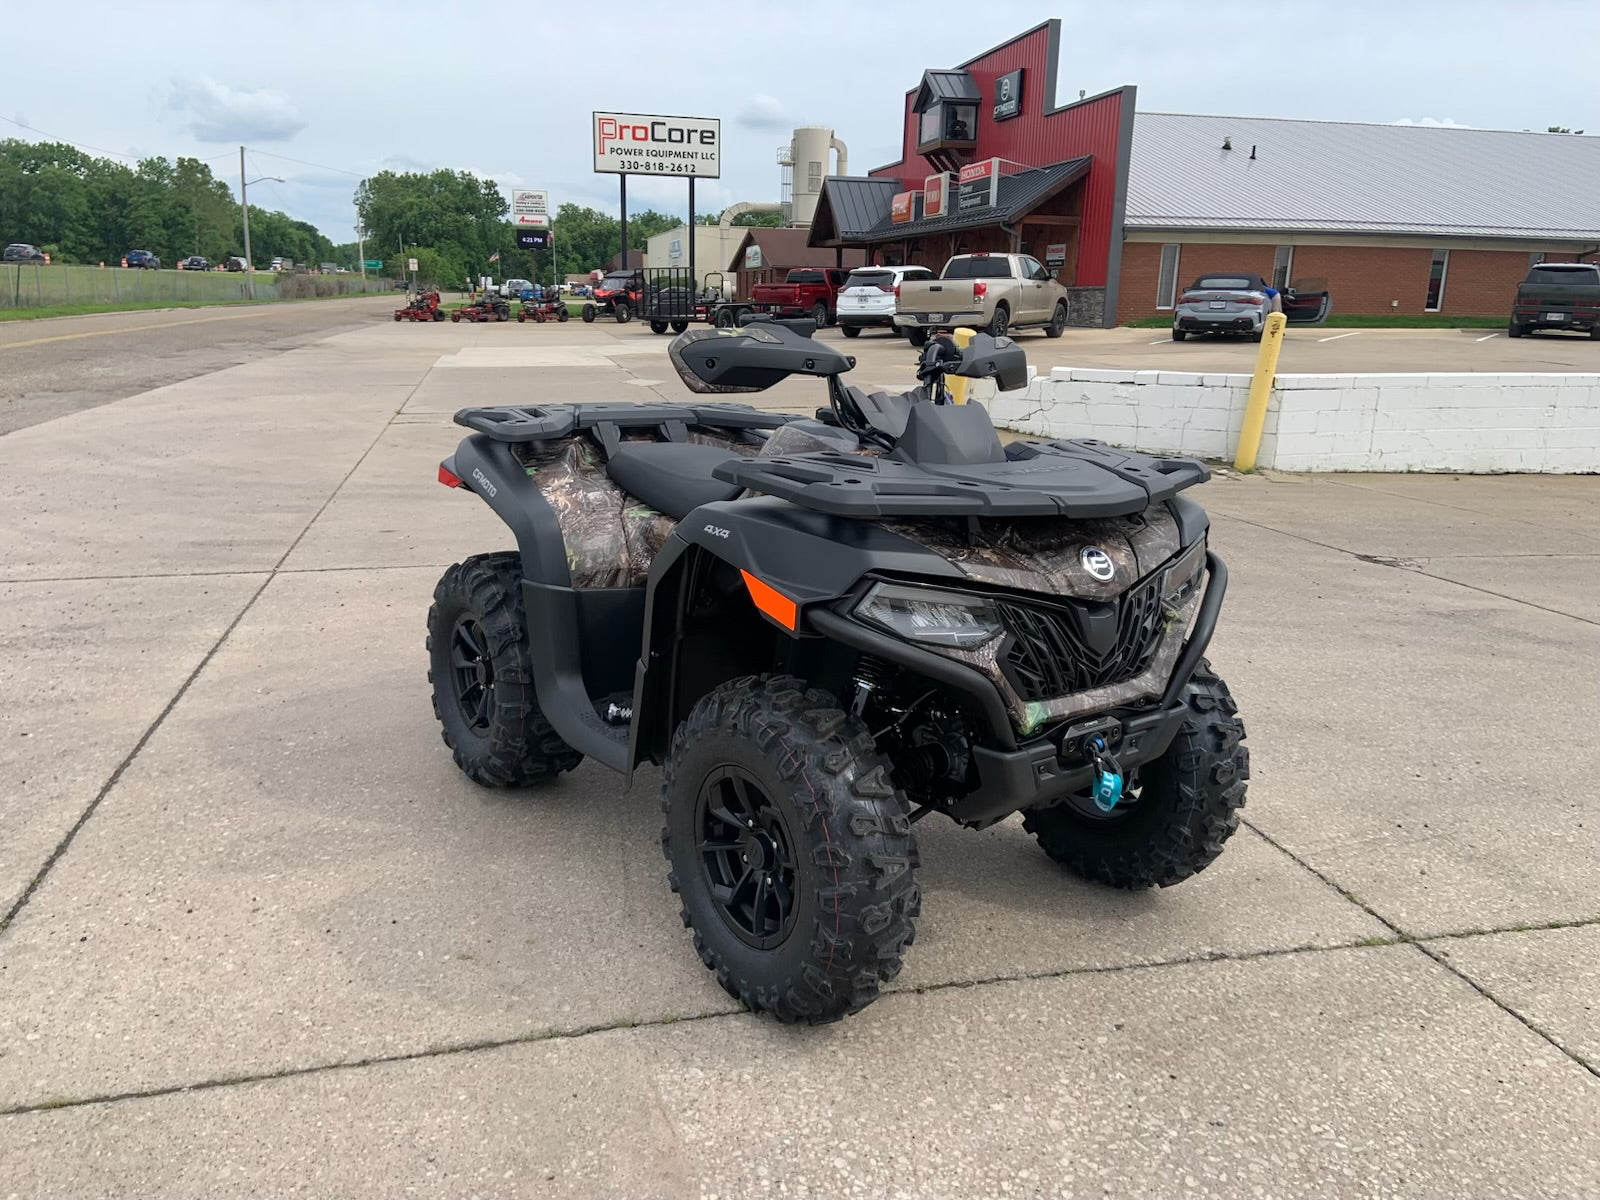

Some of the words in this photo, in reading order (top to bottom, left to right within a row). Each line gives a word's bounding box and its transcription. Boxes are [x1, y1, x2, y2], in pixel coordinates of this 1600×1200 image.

[598, 117, 715, 155] ProCore
[610, 147, 644, 157] POWER
[646, 149, 699, 160] EQUIPMENT
[701, 152, 715, 161] LLC
[620, 160, 696, 173] 330-818-2612
[961, 166, 986, 179] HONDA
[472, 468, 497, 498] CFMOTO
